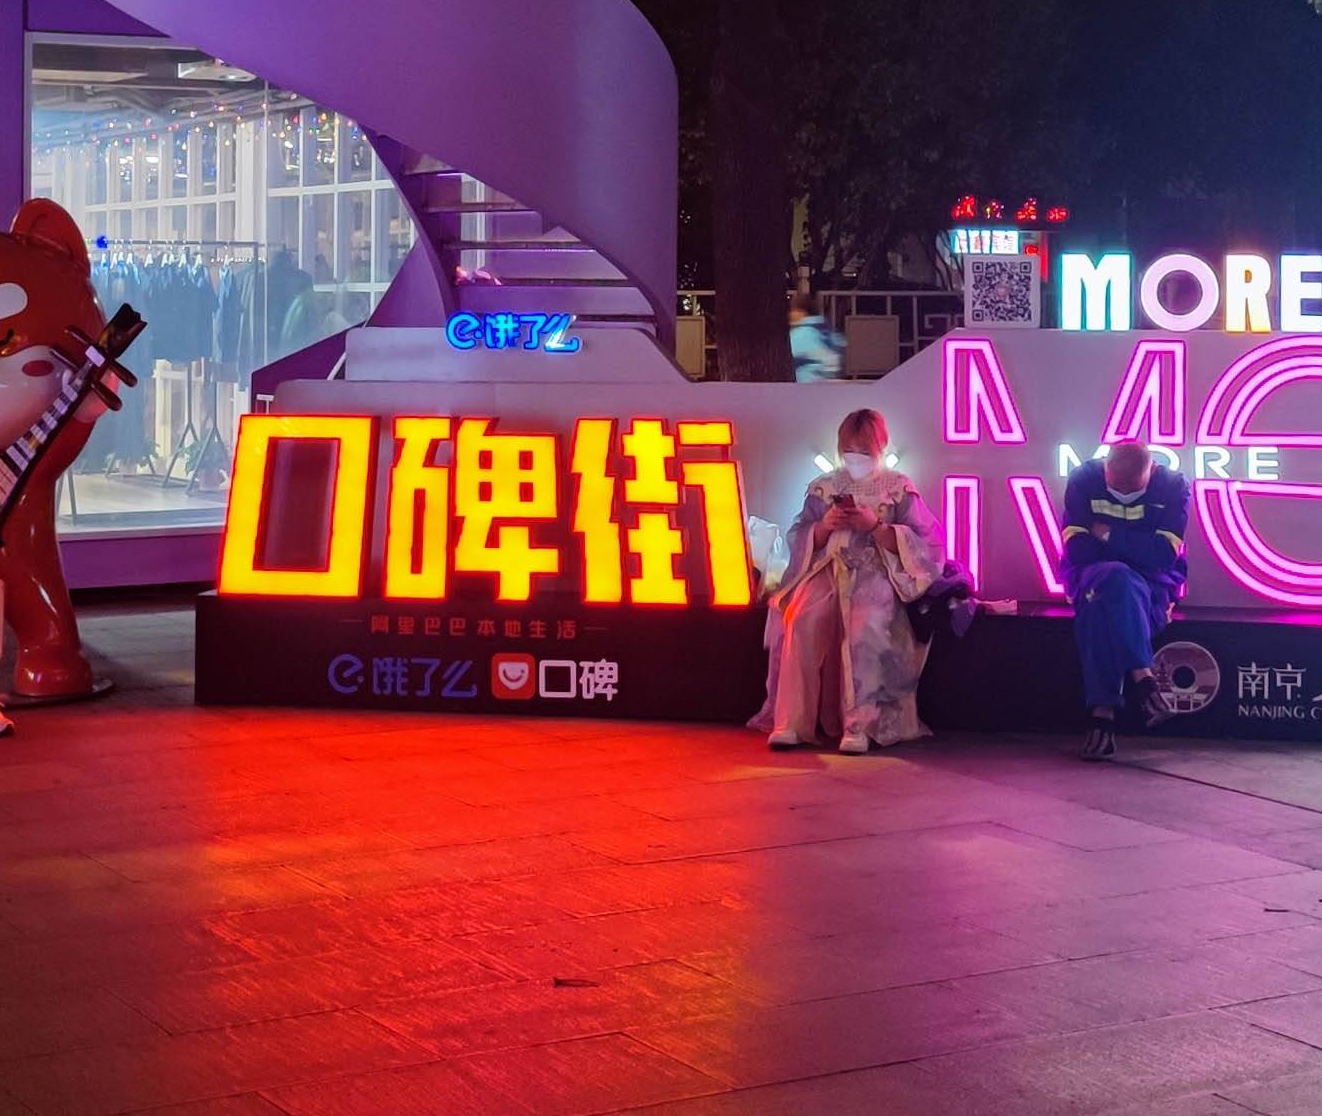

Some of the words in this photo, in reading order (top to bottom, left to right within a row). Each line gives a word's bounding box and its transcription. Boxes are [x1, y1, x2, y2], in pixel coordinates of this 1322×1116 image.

[218, 413, 754, 608] 口碑街
[371, 614, 576, 639] 阿里巴巴本地生活
[538, 657, 620, 701] 口碑
[1238, 703, 1305, 721] NANJING
